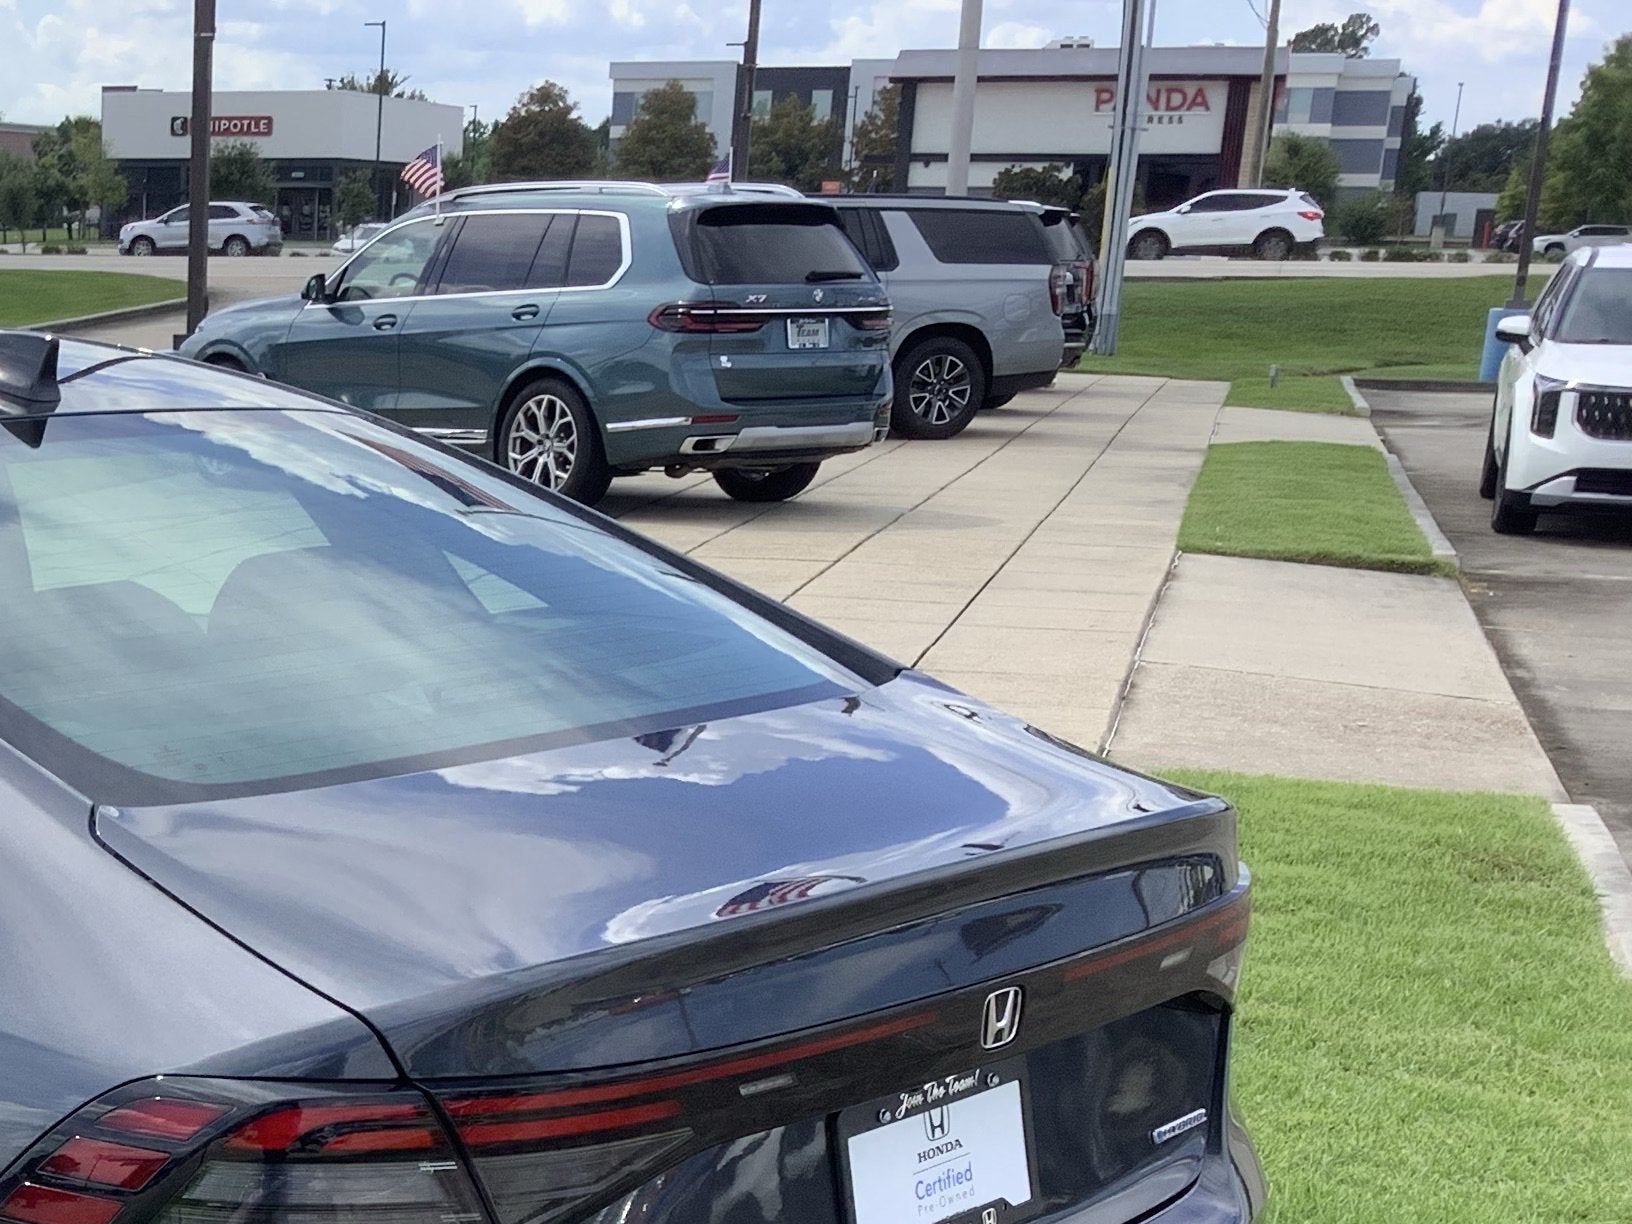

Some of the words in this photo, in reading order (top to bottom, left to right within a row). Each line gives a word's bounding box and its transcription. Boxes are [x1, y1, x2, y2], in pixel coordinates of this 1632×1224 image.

[1094, 86, 1210, 112] PNDA
[210, 119, 268, 132] IPOTLE
[1146, 115, 1183, 125] RESS
[746, 294, 767, 303] X7
[924, 1080, 945, 1102] The
[917, 1138, 963, 1164] HONDA
[914, 1160, 973, 1200] Certified
[917, 1186, 975, 1217] Pre-Owned
